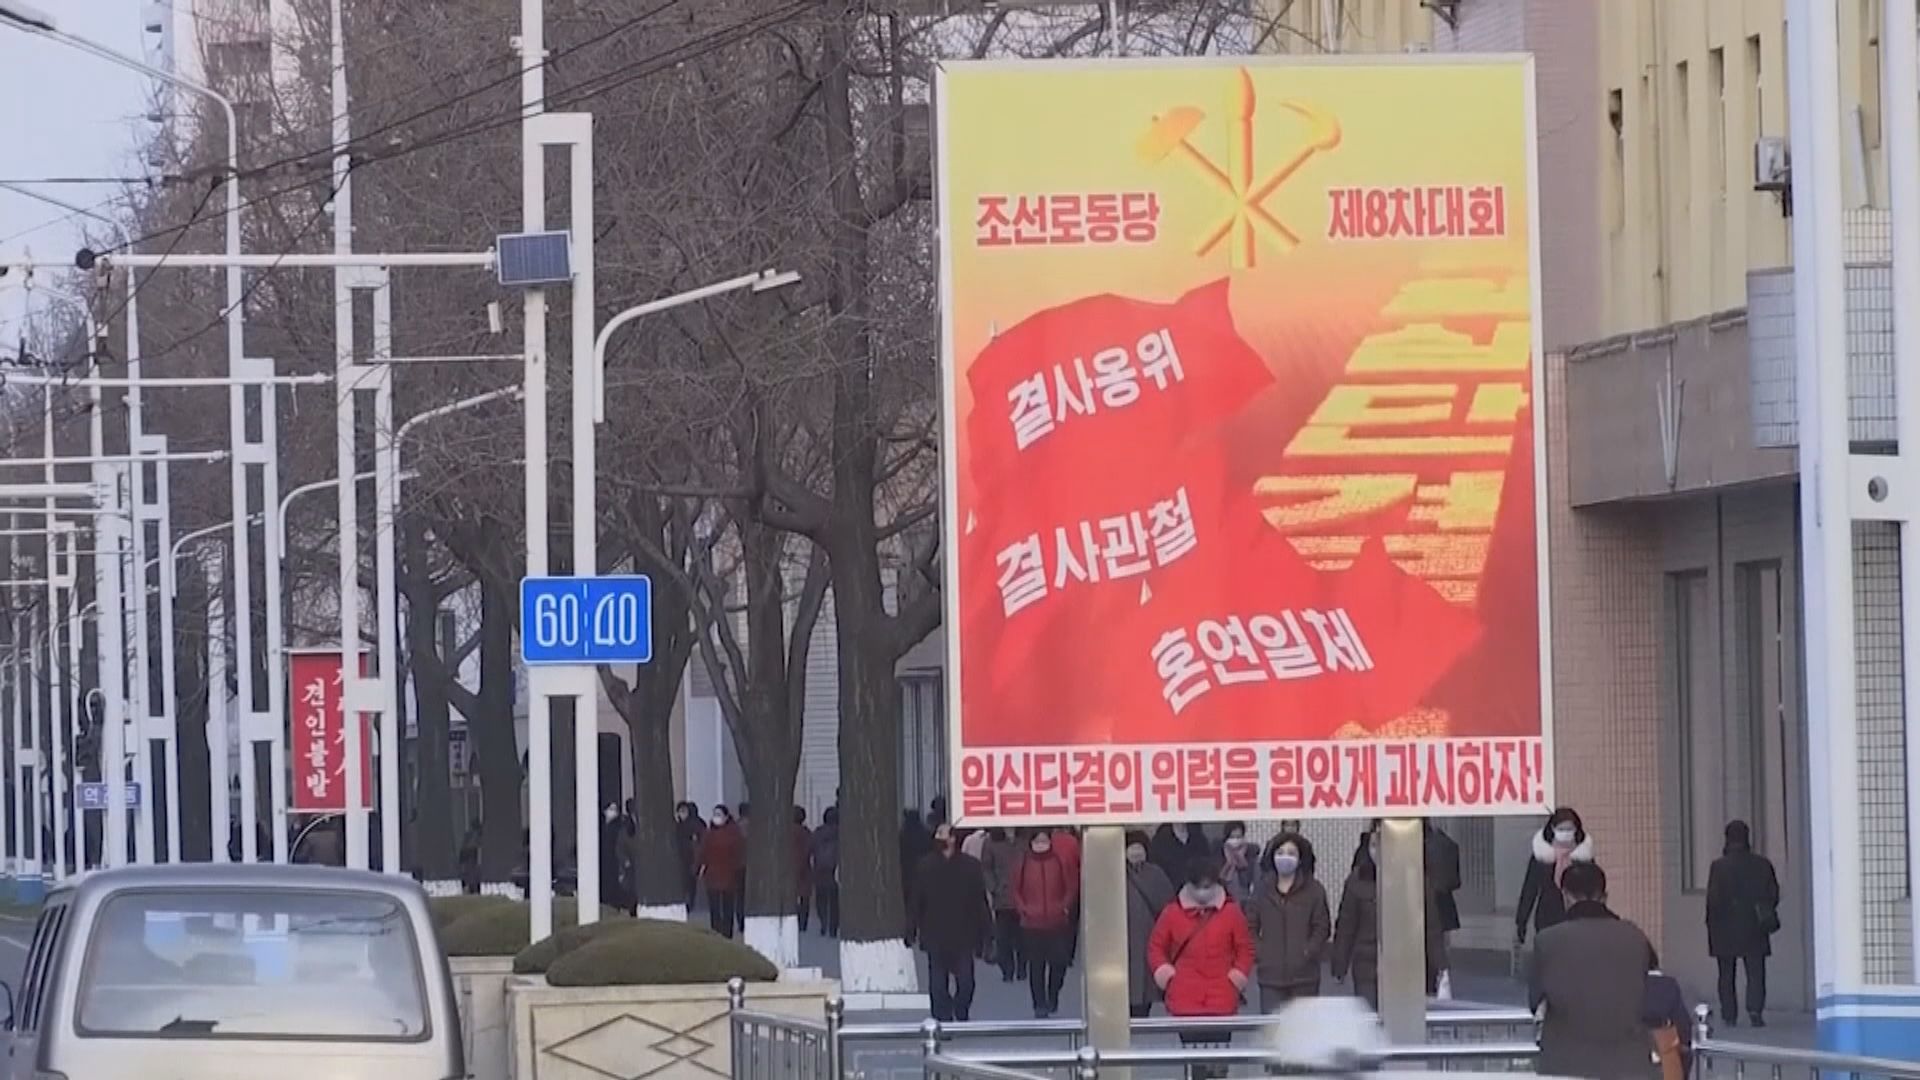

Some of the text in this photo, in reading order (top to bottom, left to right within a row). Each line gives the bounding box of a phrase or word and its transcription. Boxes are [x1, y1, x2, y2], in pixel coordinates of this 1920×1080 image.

[976, 190, 1160, 247] 조선로동당
[1328, 185, 1506, 239] 제8차대회
[1007, 327, 1186, 452] 결사옹위
[995, 486, 1198, 618] 결사관철
[535, 591, 638, 647] 60 40
[1150, 606, 1374, 715] 혼연일체
[301, 678, 331, 798] 견인불발
[961, 740, 1545, 818] 일심단결의 위력을 힘있게 과시하자!
